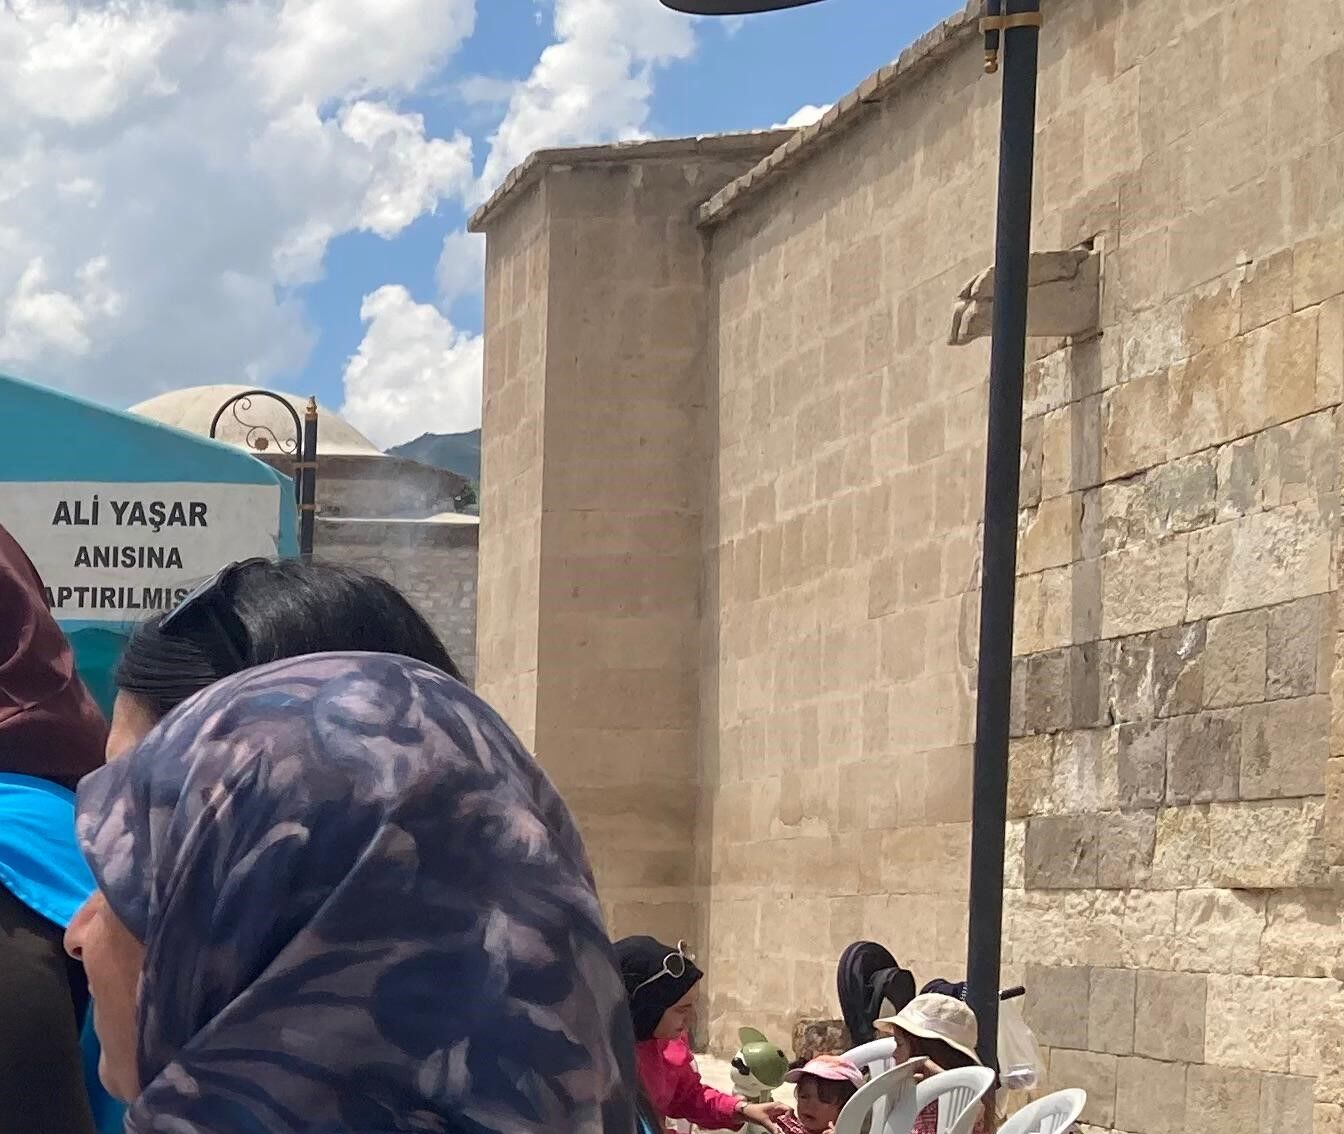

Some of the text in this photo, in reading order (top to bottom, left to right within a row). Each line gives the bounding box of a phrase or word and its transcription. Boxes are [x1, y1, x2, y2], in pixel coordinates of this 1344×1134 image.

[52, 495, 208, 532] ALİ YAŞAR
[74, 546, 183, 569] ANISINA
